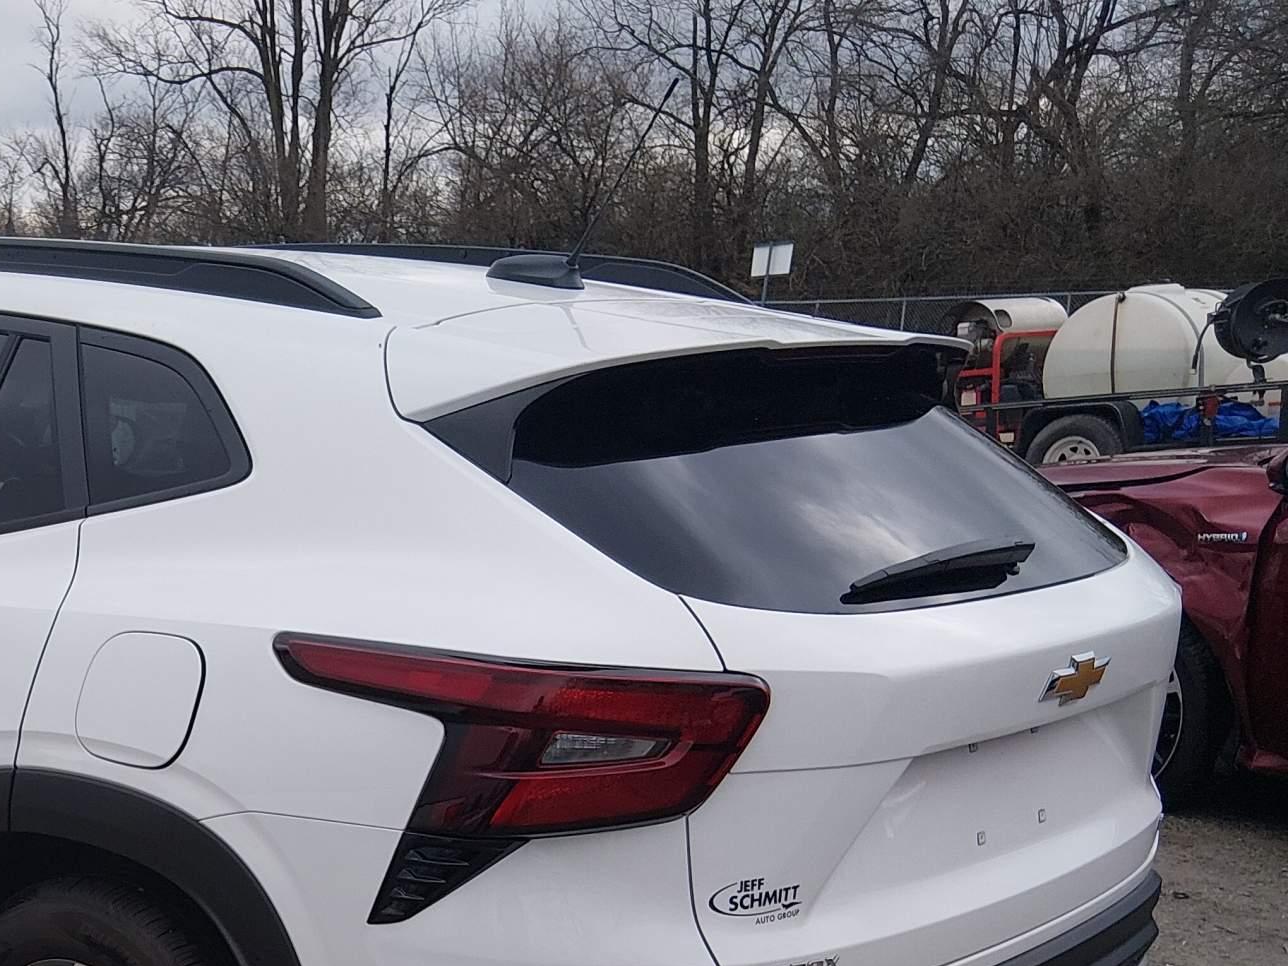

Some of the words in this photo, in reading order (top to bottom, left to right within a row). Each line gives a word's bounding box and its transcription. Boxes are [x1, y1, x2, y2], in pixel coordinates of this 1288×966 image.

[1197, 533, 1239, 542] HYBRID
[737, 878, 765, 894] JEFF
[728, 884, 800, 912] SCHMITT
[755, 914, 776, 926] AUTO
[776, 908, 800, 922] GROUP
